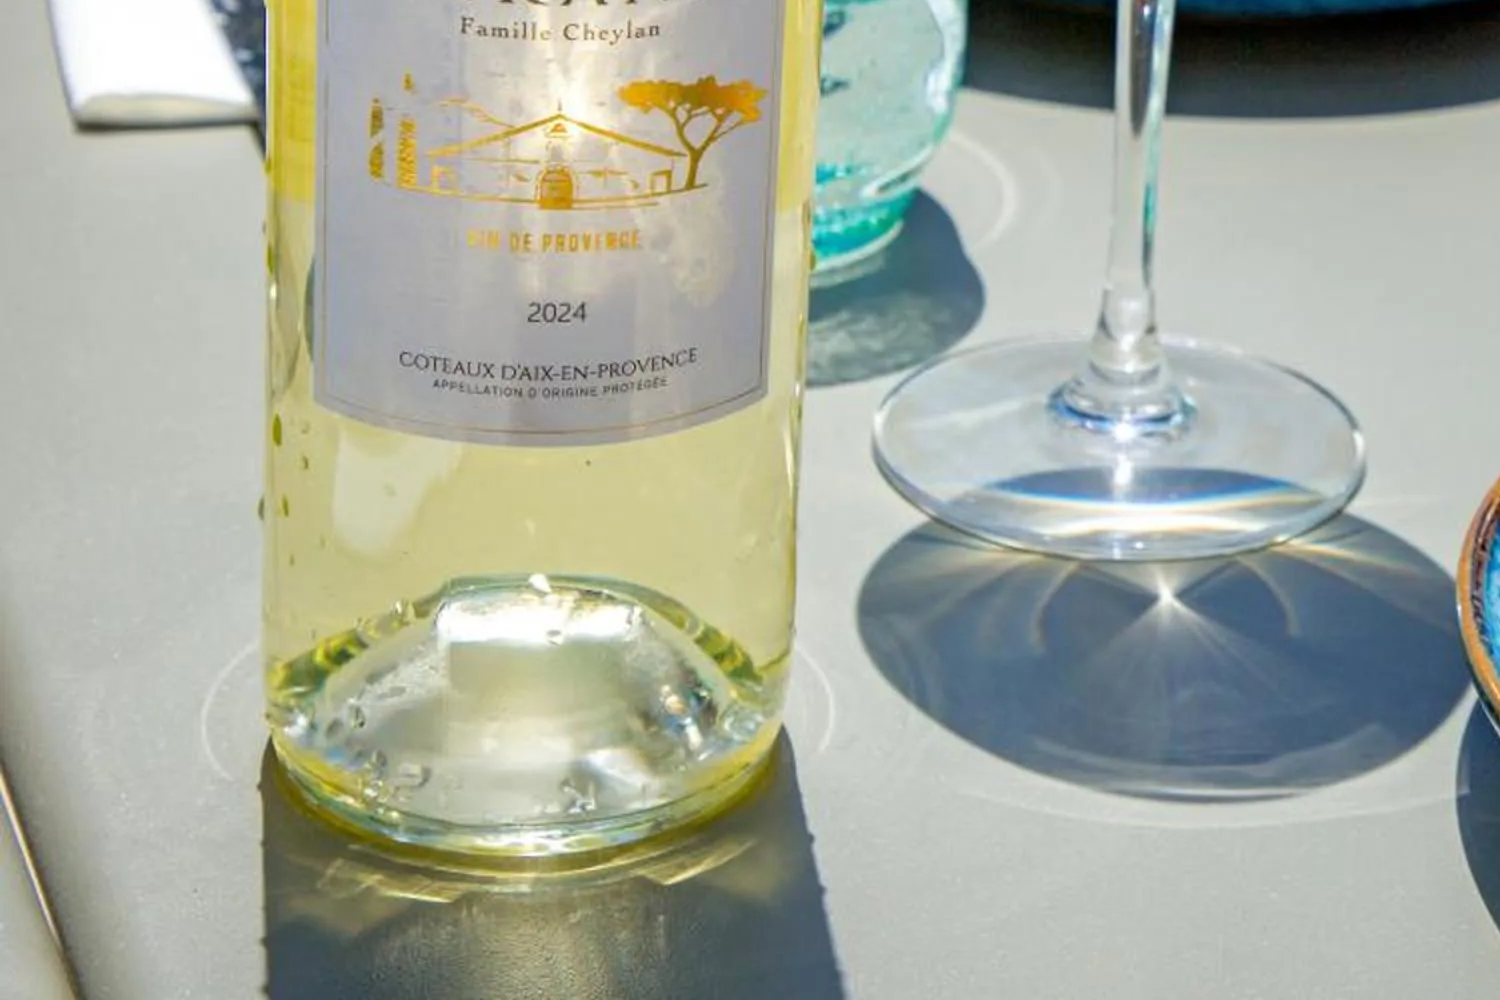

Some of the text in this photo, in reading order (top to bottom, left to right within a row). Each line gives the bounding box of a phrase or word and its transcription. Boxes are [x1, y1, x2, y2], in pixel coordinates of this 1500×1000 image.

[460, 16, 661, 46] Famille Cheylan
[509, 231, 533, 252] DE
[527, 302, 588, 324] 2024
[399, 347, 698, 382] COTEAUX D'AIX-EN-PROVENCE
[432, 378, 523, 398] APPELLATION
[528, 385, 599, 398] D'ORIGINE
